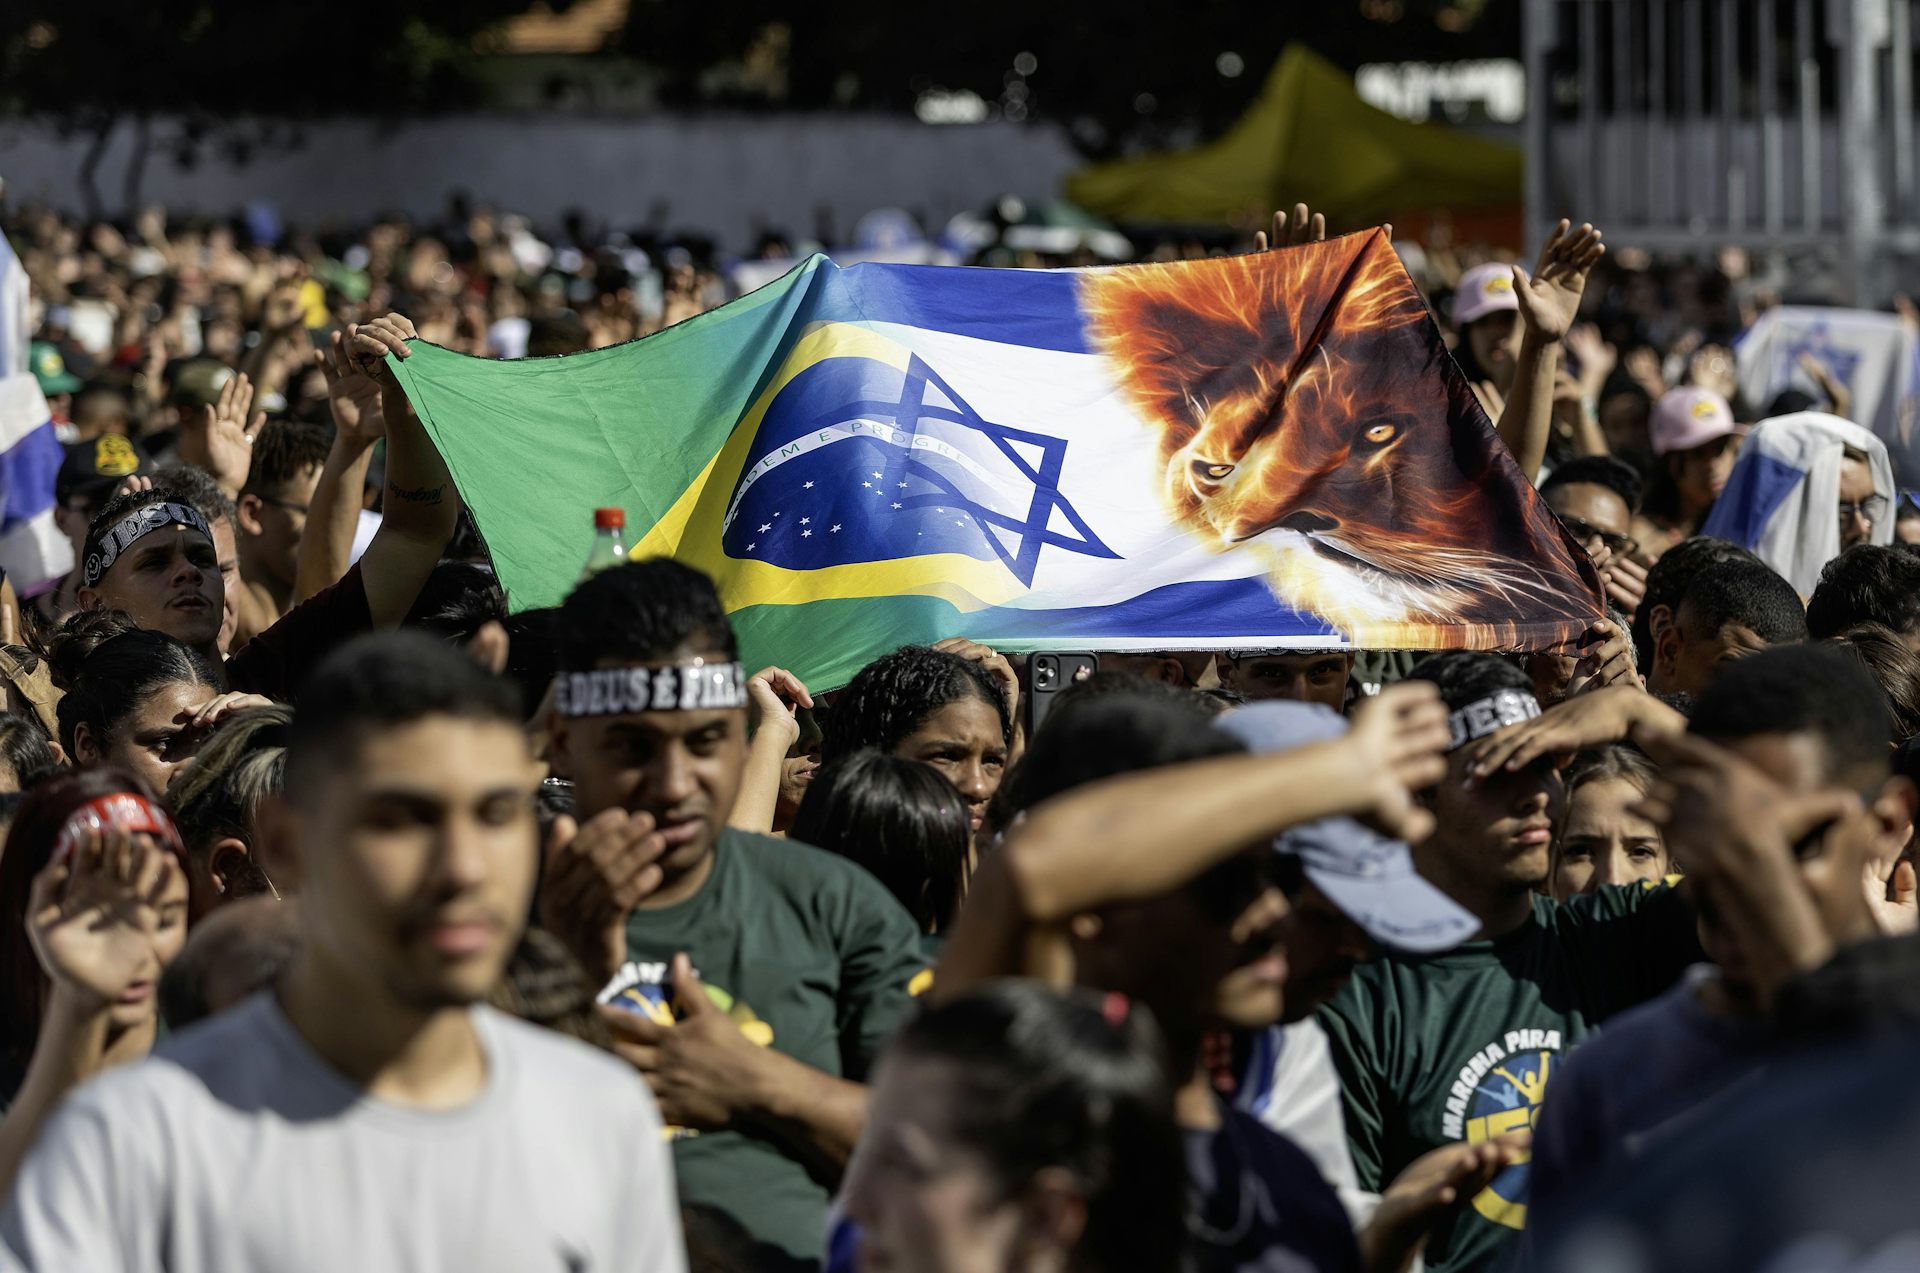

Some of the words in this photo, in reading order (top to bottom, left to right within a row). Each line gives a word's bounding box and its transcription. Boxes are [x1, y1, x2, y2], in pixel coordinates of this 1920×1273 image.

[818, 431, 833, 443] E
[570, 667, 650, 715] DEUS
[651, 666, 678, 708] É
[1442, 1042, 1506, 1140] MARCHA
[1504, 1028, 1561, 1053] PARA
